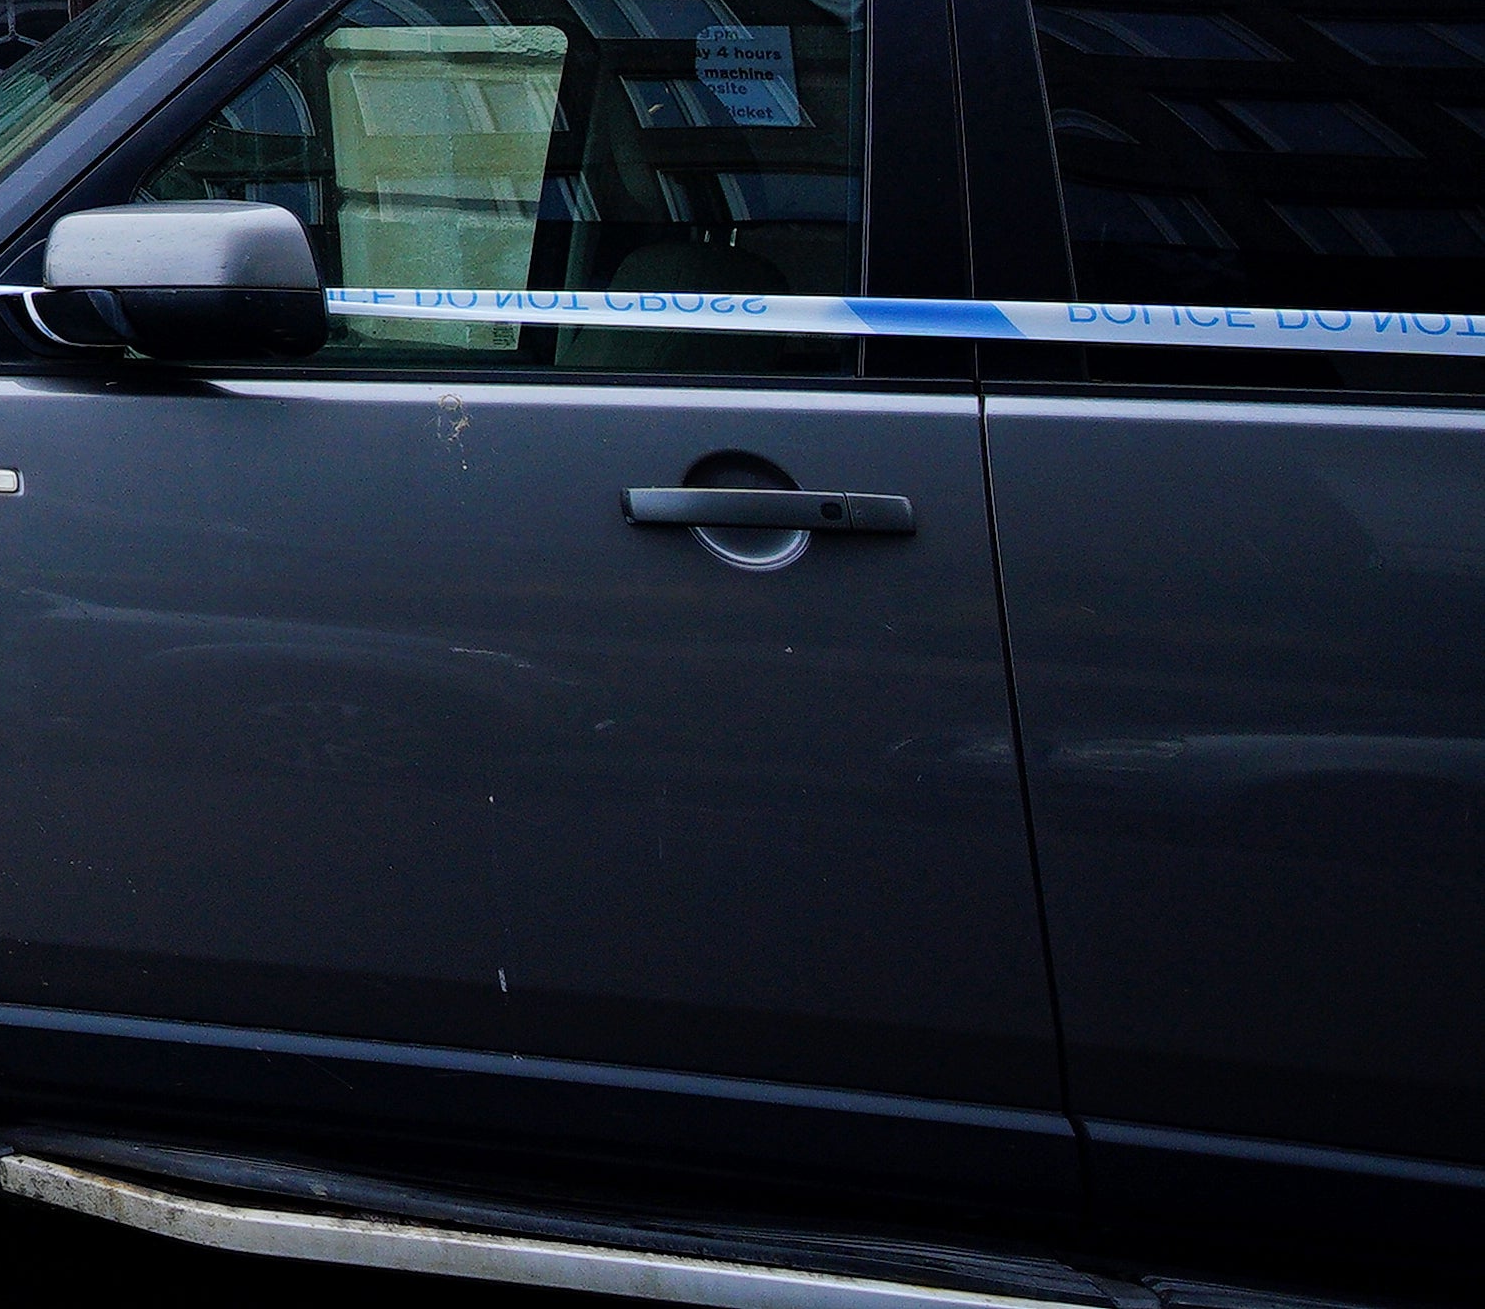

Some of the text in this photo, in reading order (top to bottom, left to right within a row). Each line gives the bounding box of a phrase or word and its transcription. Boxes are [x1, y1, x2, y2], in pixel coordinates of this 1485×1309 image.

[716, 47, 729, 58] 4
[733, 47, 782, 60] hours
[704, 67, 775, 81] machine
